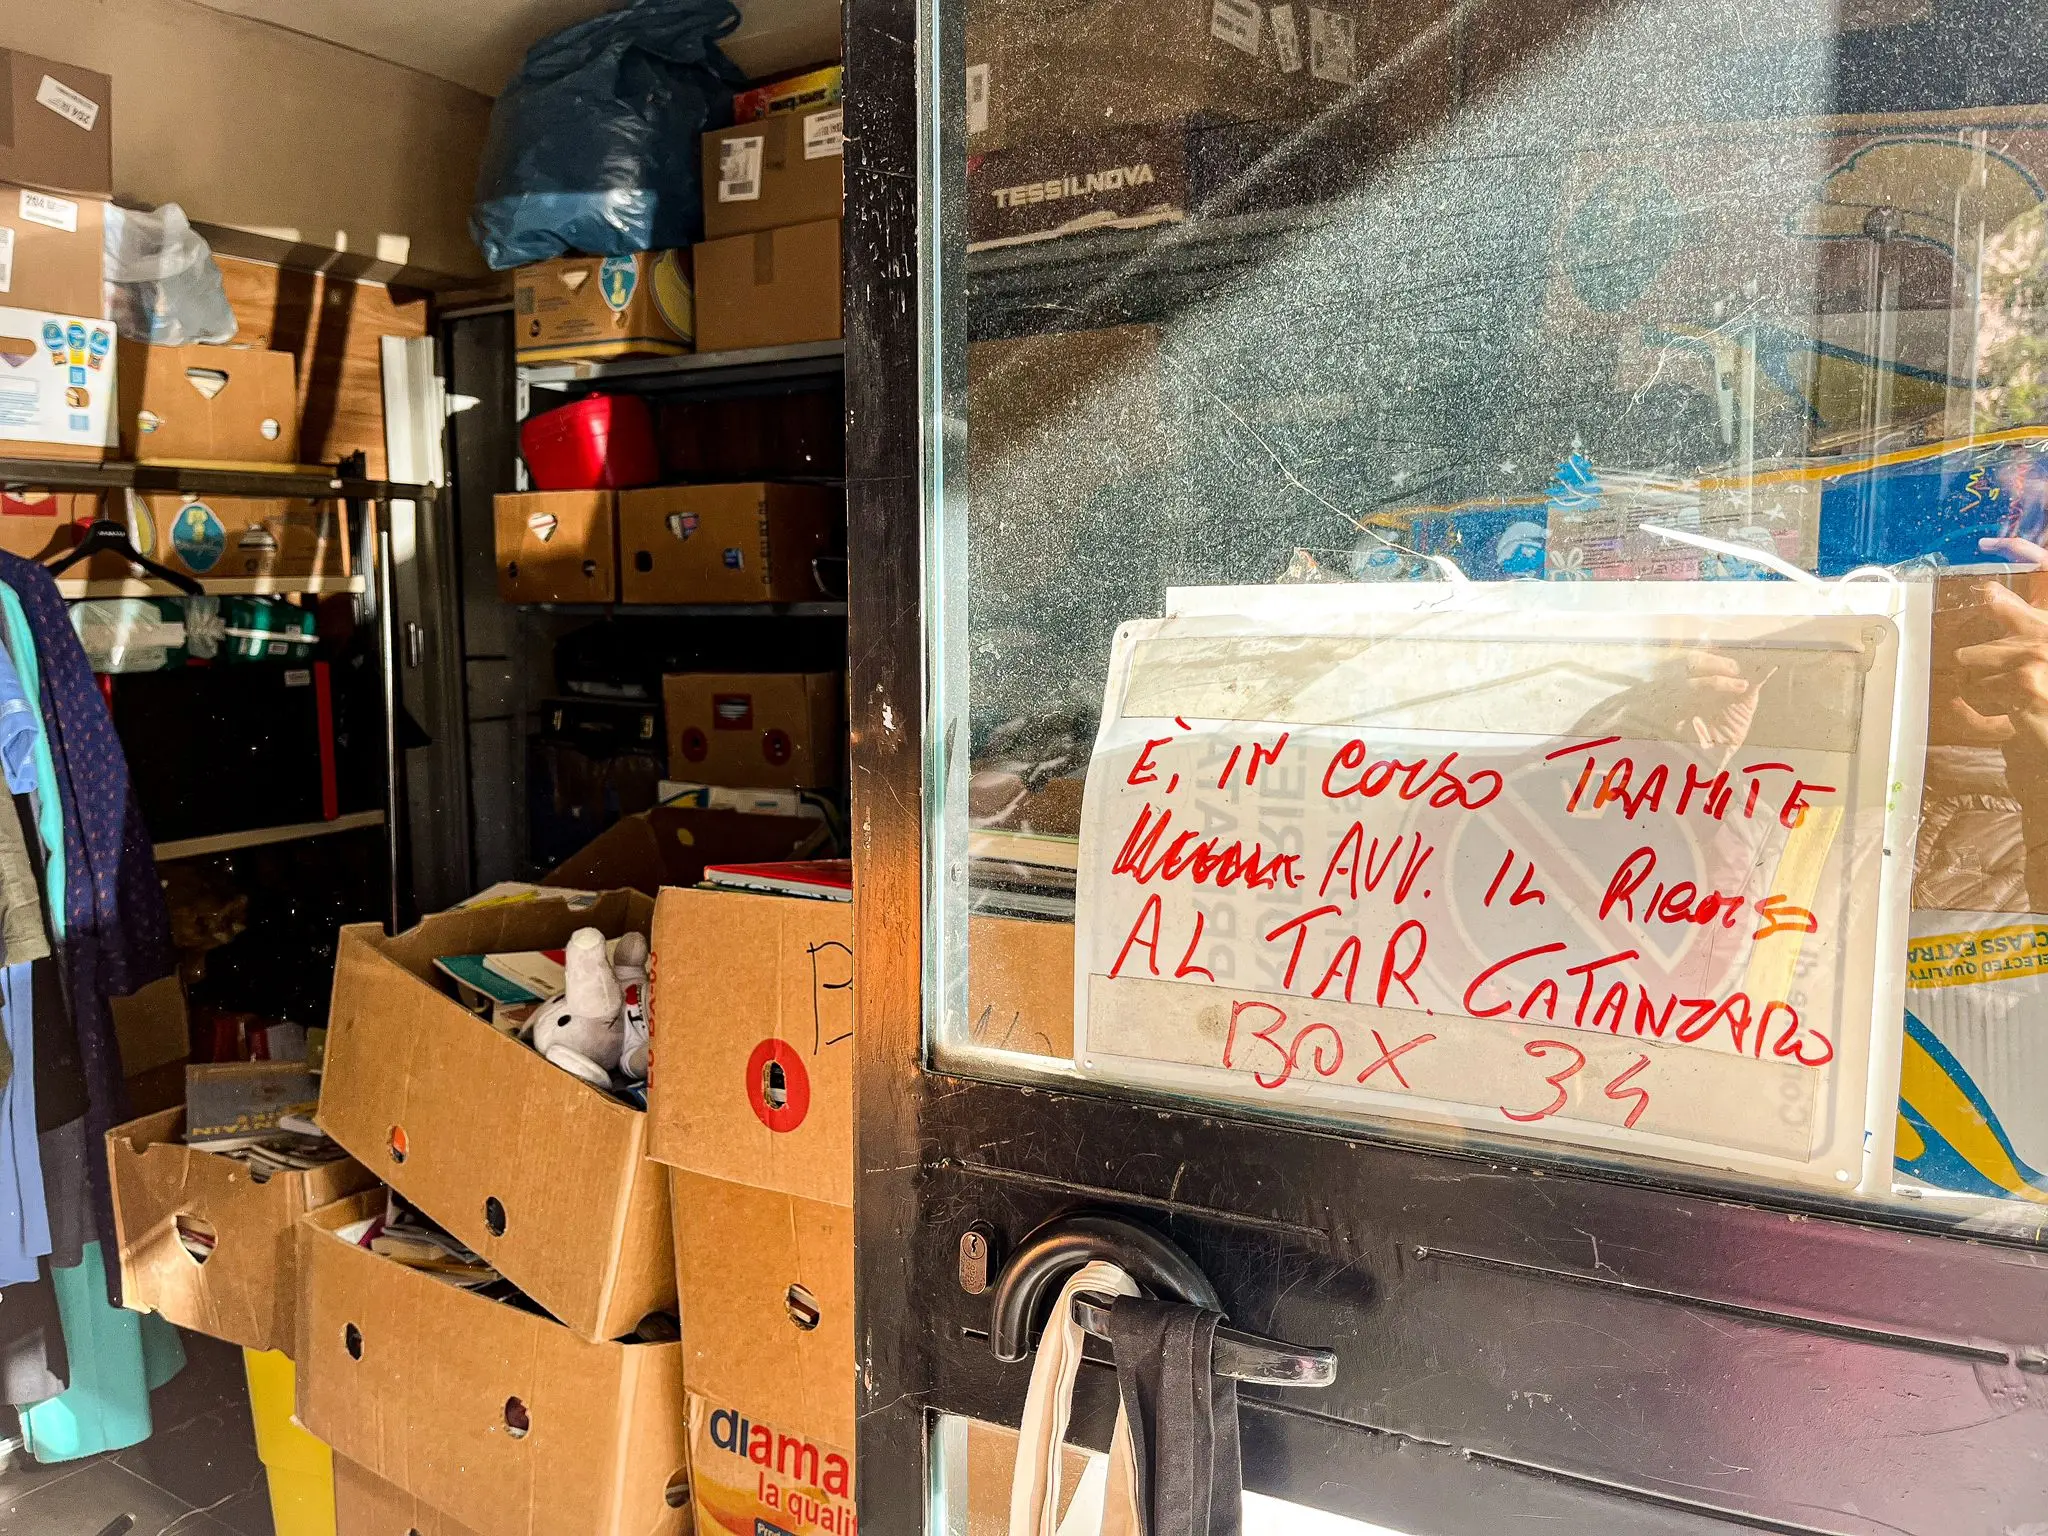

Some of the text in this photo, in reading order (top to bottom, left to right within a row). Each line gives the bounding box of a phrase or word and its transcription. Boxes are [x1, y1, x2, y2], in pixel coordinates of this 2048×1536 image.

[992, 163, 1156, 209] TESSILNOVA
[1218, 733, 1290, 790] IN
[1546, 736, 1837, 830] TRAMITE
[1484, 849, 1546, 907] IL
[1108, 893, 1214, 982] AL
[1908, 932, 2048, 963] CLASS EXTRA
[1908, 956, 2048, 982] ELECTED QUALITY
[1223, 998, 1435, 1089] BOX
[758, 1472, 780, 1509] la
